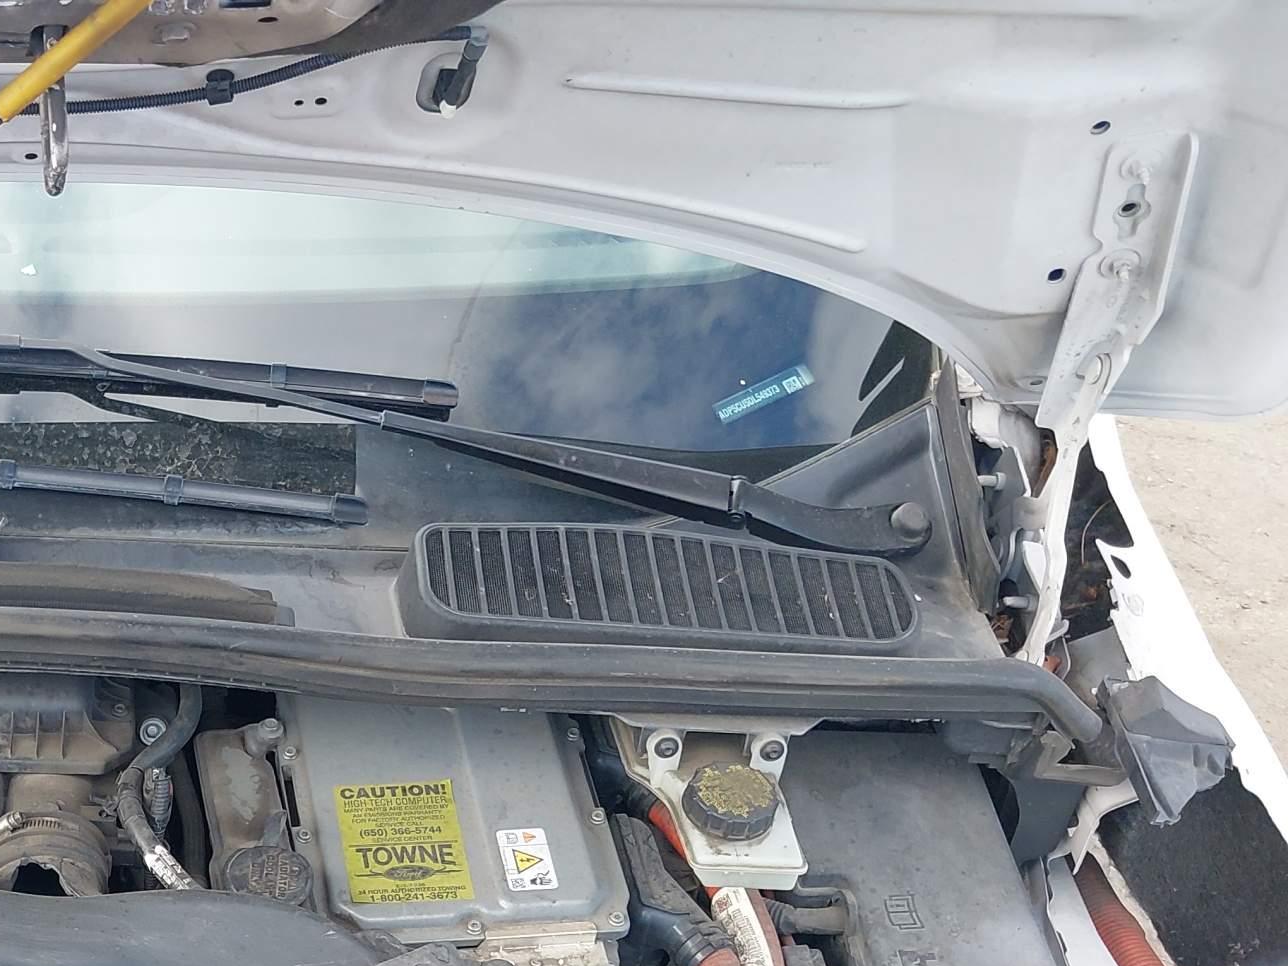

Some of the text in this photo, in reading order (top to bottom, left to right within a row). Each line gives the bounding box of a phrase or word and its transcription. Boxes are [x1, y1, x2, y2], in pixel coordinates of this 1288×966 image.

[340, 784, 446, 799] CAUTION!
[395, 796, 447, 805] COMPUTER
[359, 826, 442, 839] (650) 366-5744
[355, 844, 457, 869] TOWNE
[370, 891, 458, 902] 1-800-241-3673
